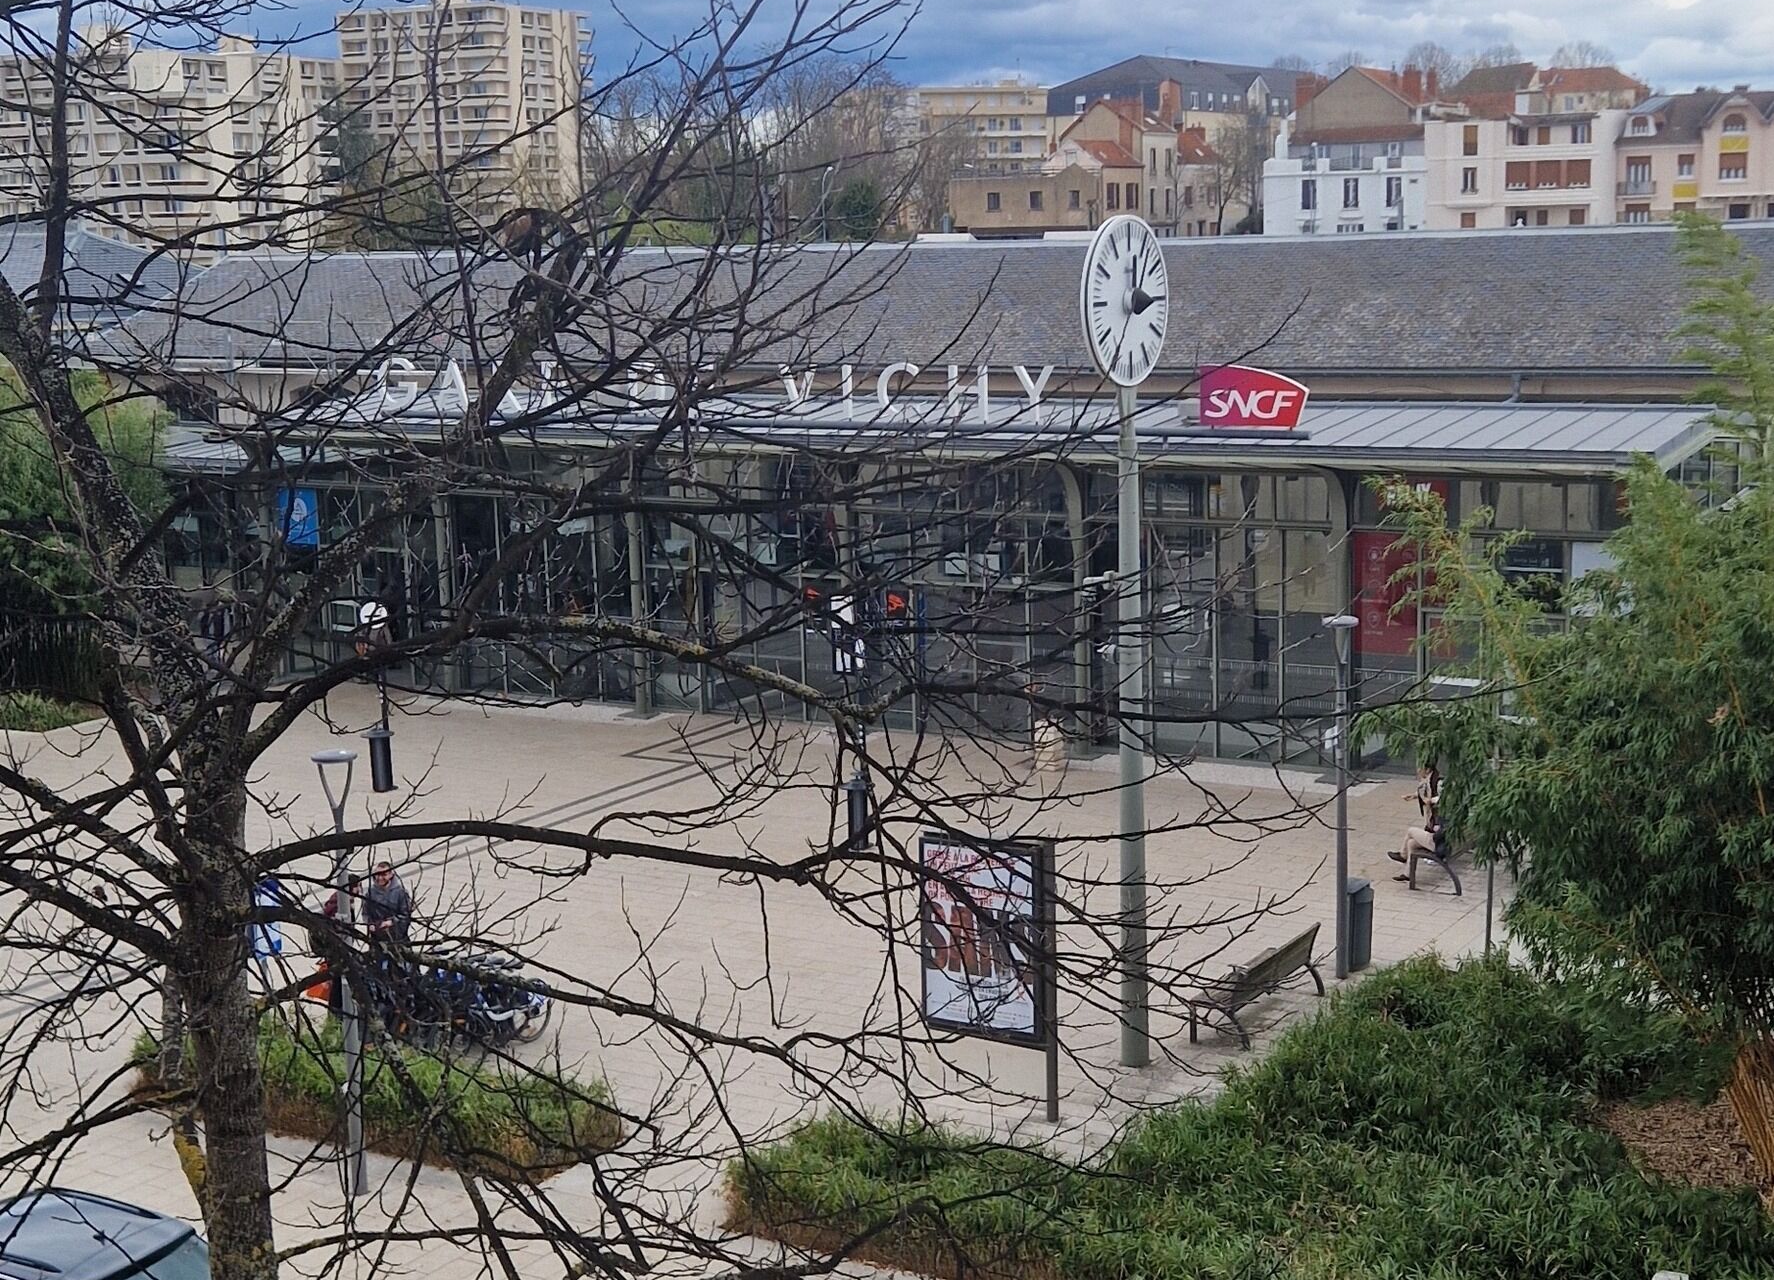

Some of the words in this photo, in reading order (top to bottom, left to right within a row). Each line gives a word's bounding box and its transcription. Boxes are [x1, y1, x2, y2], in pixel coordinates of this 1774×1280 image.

[377, 357, 568, 414] GAE
[778, 362, 1055, 423] VICHY
[1204, 389, 1298, 419] SNCF
